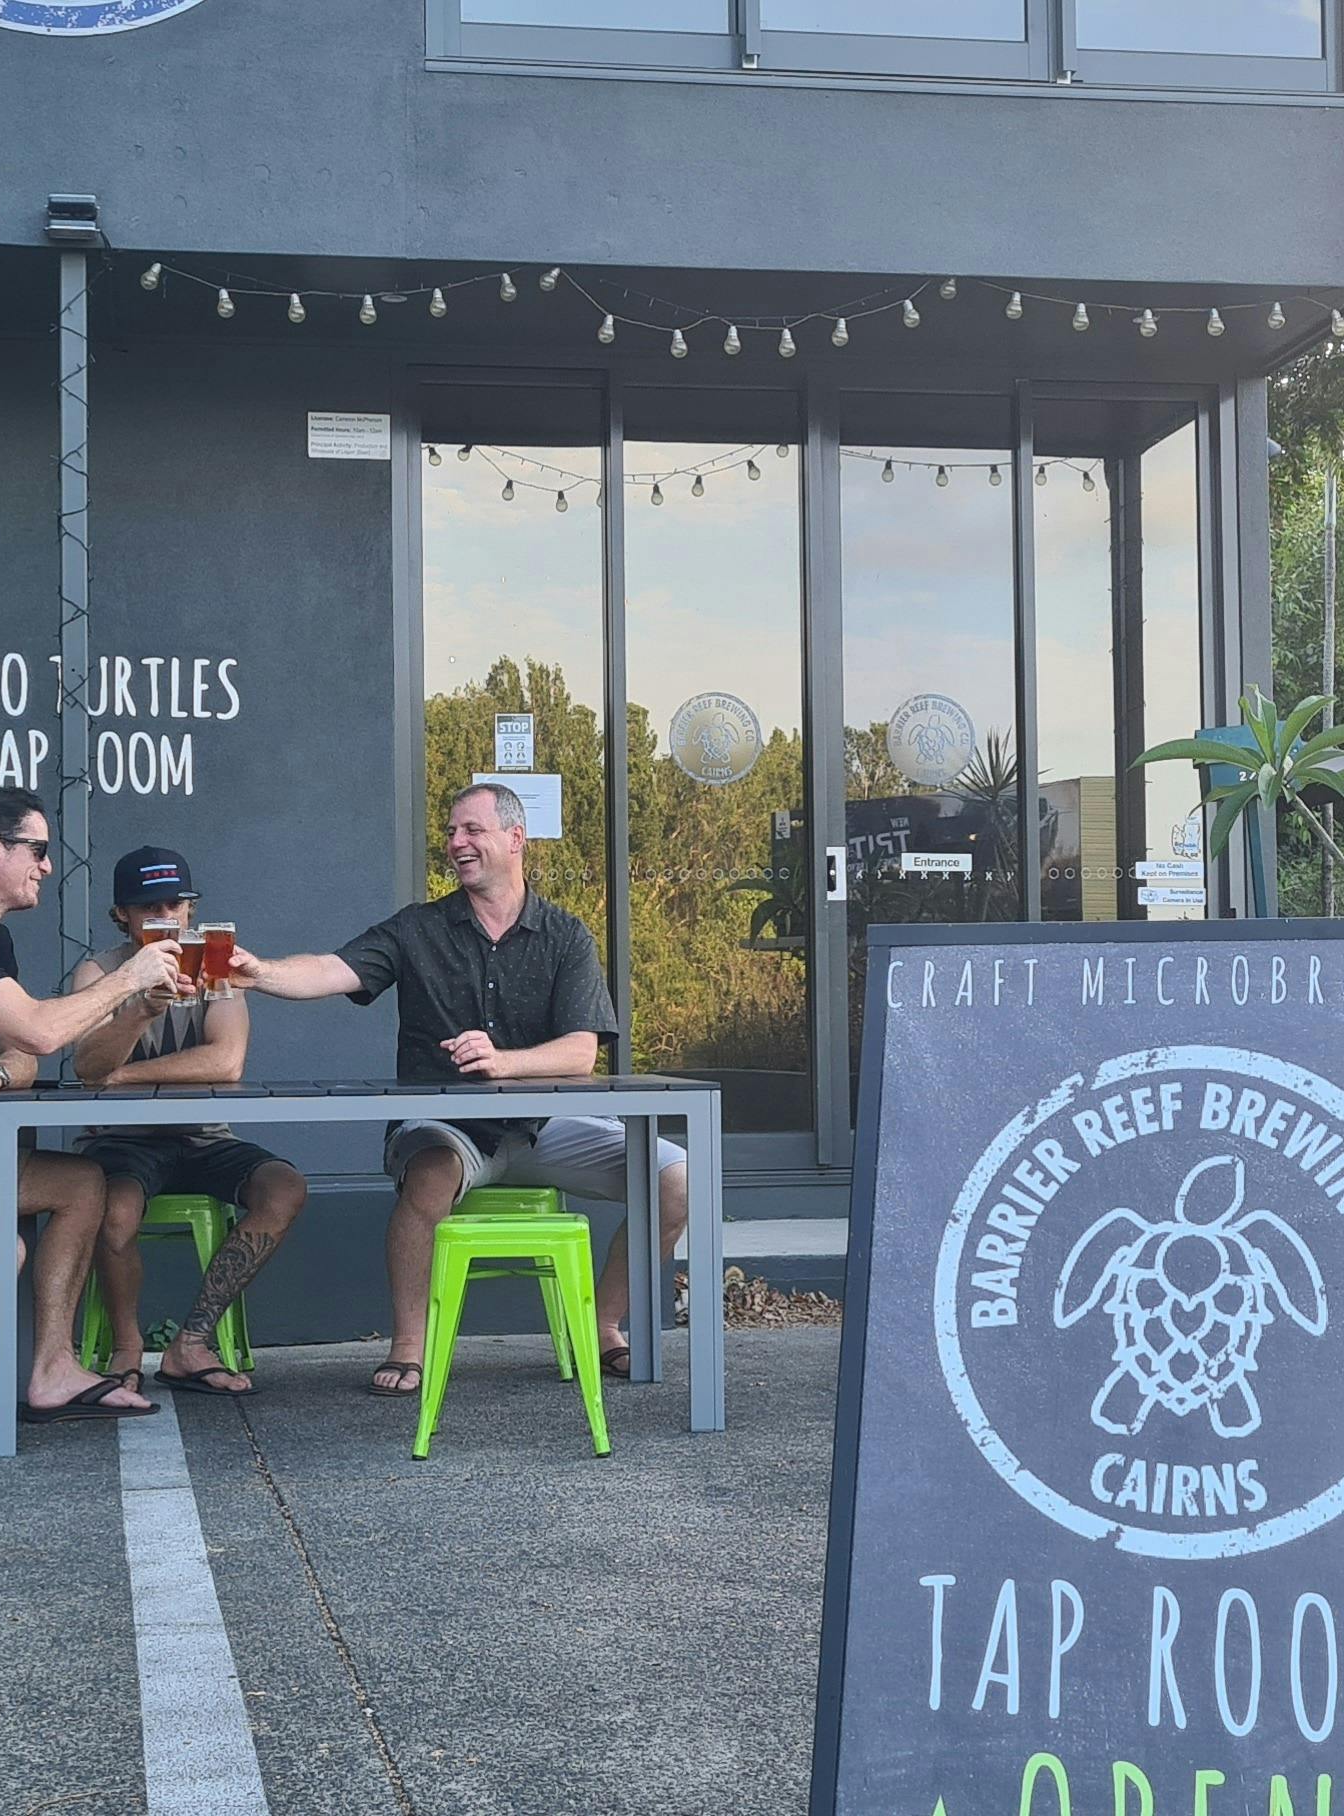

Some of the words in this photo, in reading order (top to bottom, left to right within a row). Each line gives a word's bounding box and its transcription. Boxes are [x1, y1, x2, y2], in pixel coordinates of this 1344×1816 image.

[499, 722, 529, 733] STOP
[716, 699, 751, 728] BREWING
[909, 700, 929, 713] REEF
[87, 730, 194, 796] OOM
[913, 856, 960, 868] Entrance
[886, 958, 1040, 1009] CRAFT
[970, 1137, 1082, 1329] BARRIER
[1071, 1081, 1184, 1158] REEF
[1090, 1453, 1269, 1517] CAIRNS
[918, 1574, 1086, 1719] TAP
